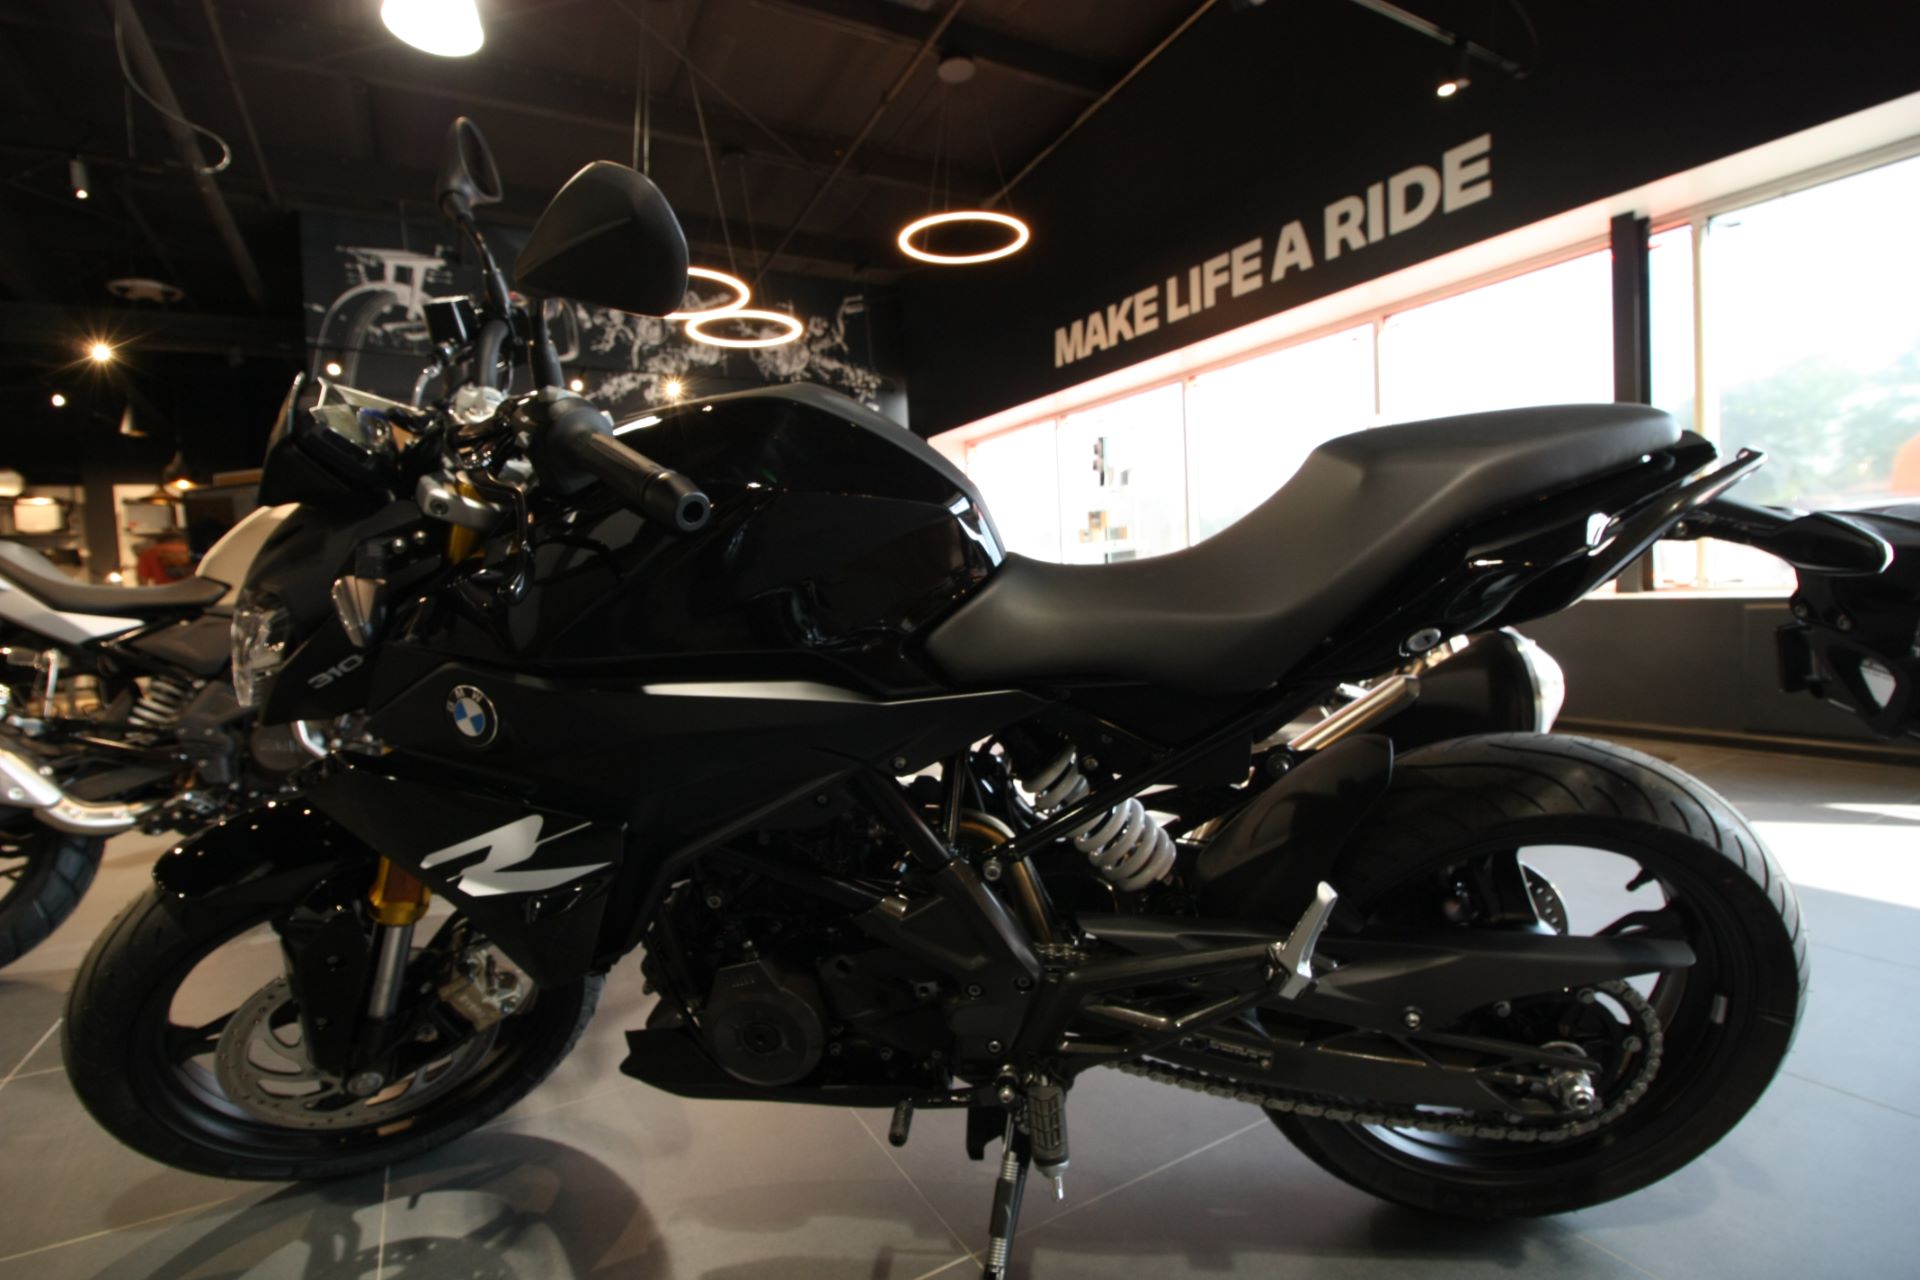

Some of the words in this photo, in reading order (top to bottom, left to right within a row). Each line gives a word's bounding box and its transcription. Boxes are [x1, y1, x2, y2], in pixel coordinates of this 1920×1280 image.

[1054, 284, 1160, 368] MAKE
[1166, 236, 1264, 324] LIFE
[1270, 219, 1315, 283] A
[1323, 132, 1493, 262] RIDE
[306, 653, 365, 690] 310
